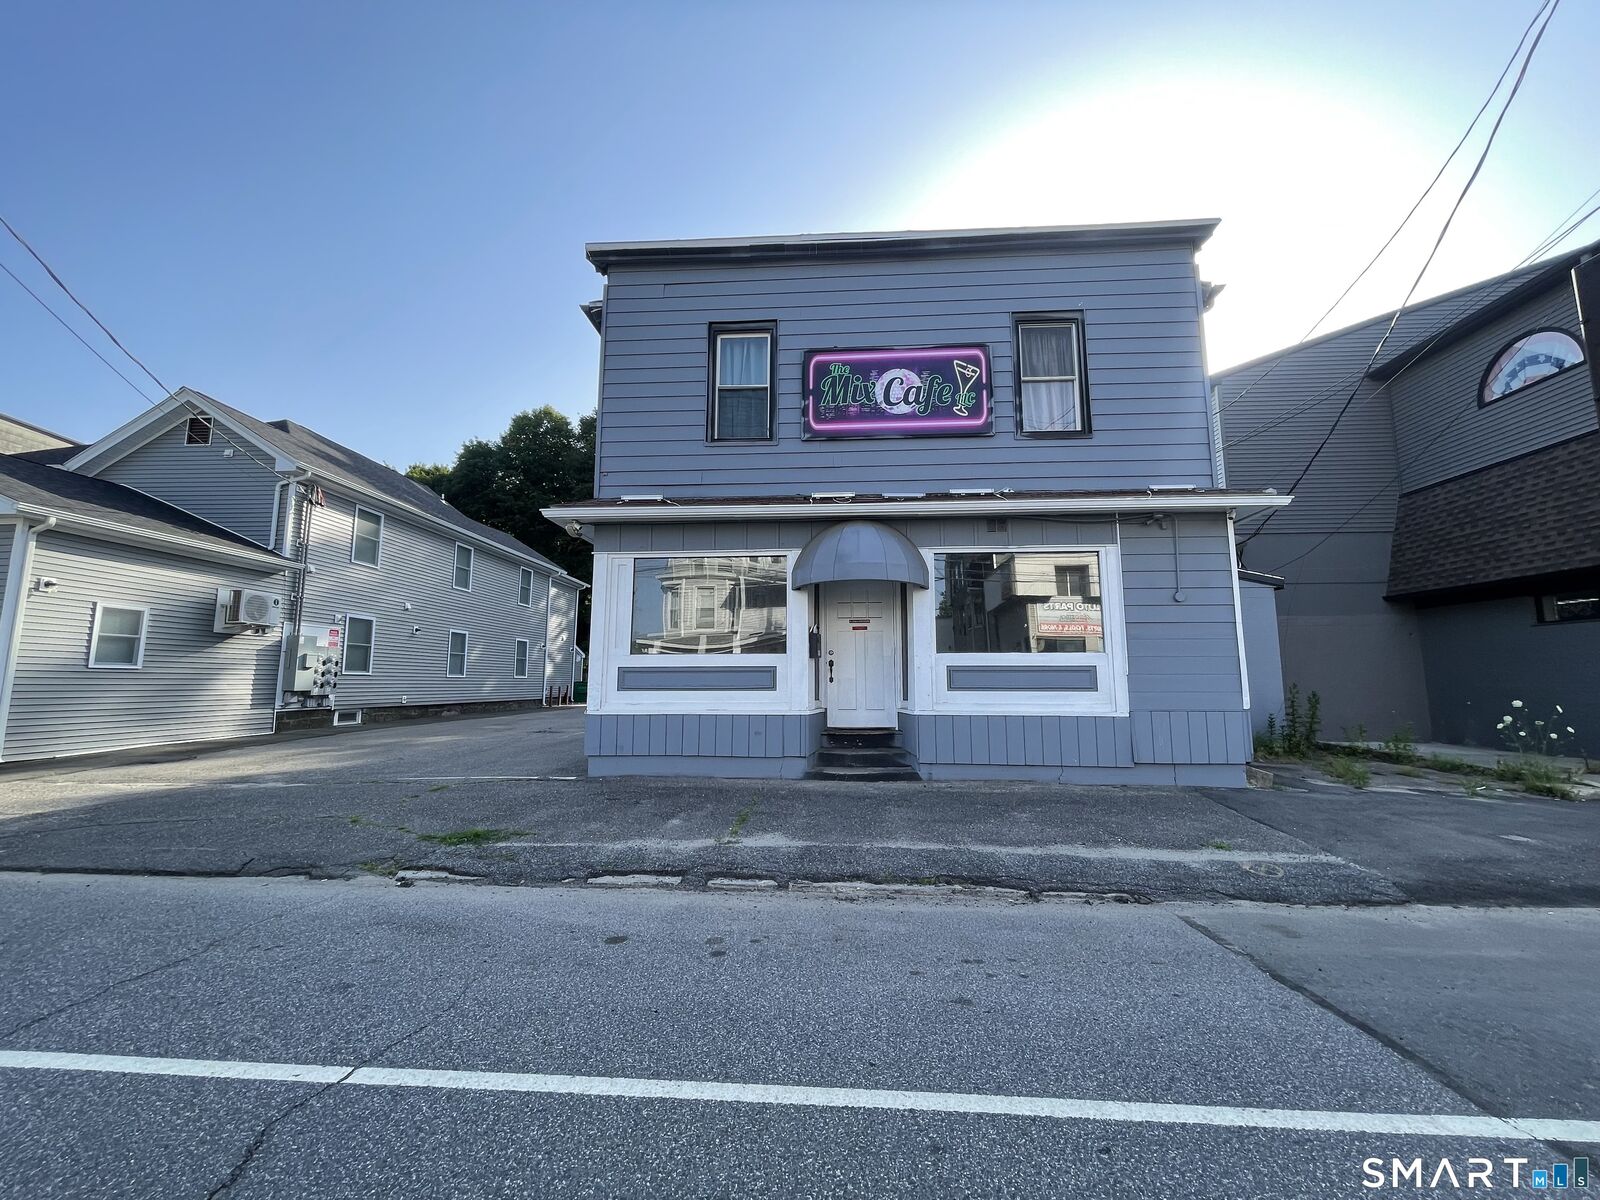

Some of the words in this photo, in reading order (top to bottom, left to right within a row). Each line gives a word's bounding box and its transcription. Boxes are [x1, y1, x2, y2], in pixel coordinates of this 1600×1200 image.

[830, 363, 851, 375] The
[820, 373, 878, 406] Mix
[882, 374, 953, 415] Cafe
